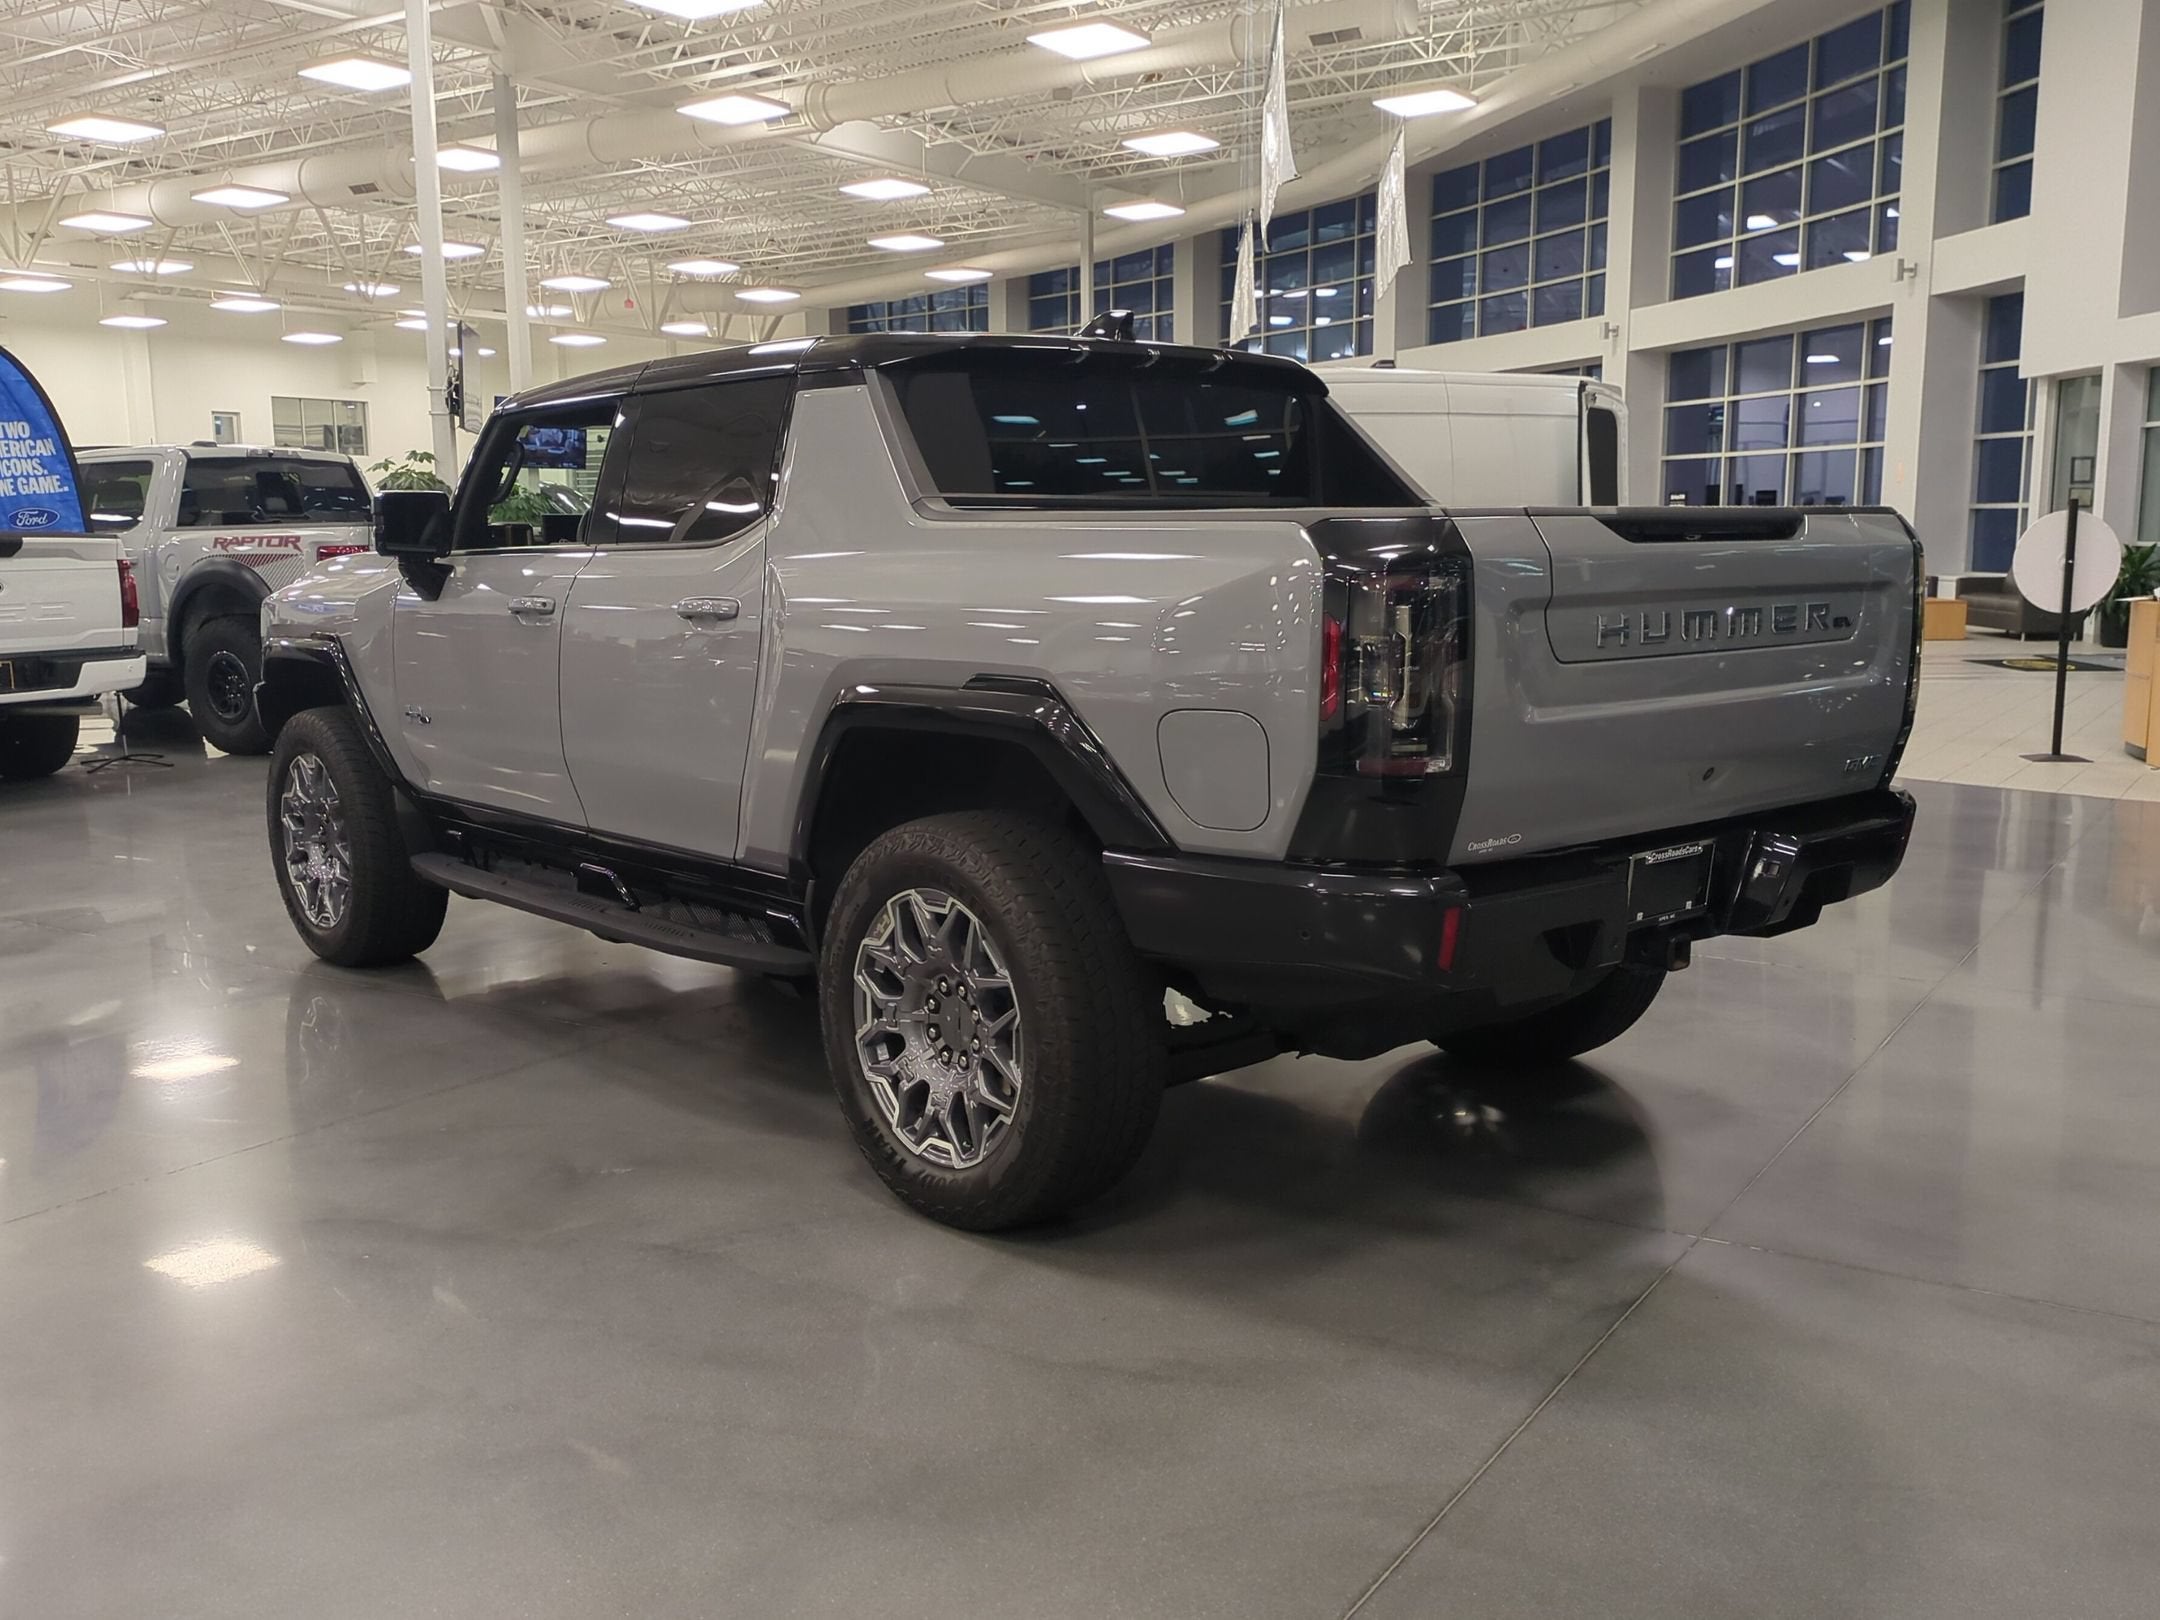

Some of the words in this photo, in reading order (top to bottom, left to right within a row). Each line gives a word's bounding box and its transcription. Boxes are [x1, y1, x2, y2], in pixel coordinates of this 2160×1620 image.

[0, 438, 57, 458] ERICAN
[17, 475, 69, 495] GAME.
[16, 510, 48, 526] Ford
[212, 534, 303, 553] RAPTOR
[1596, 602, 1830, 648] HUMMER
